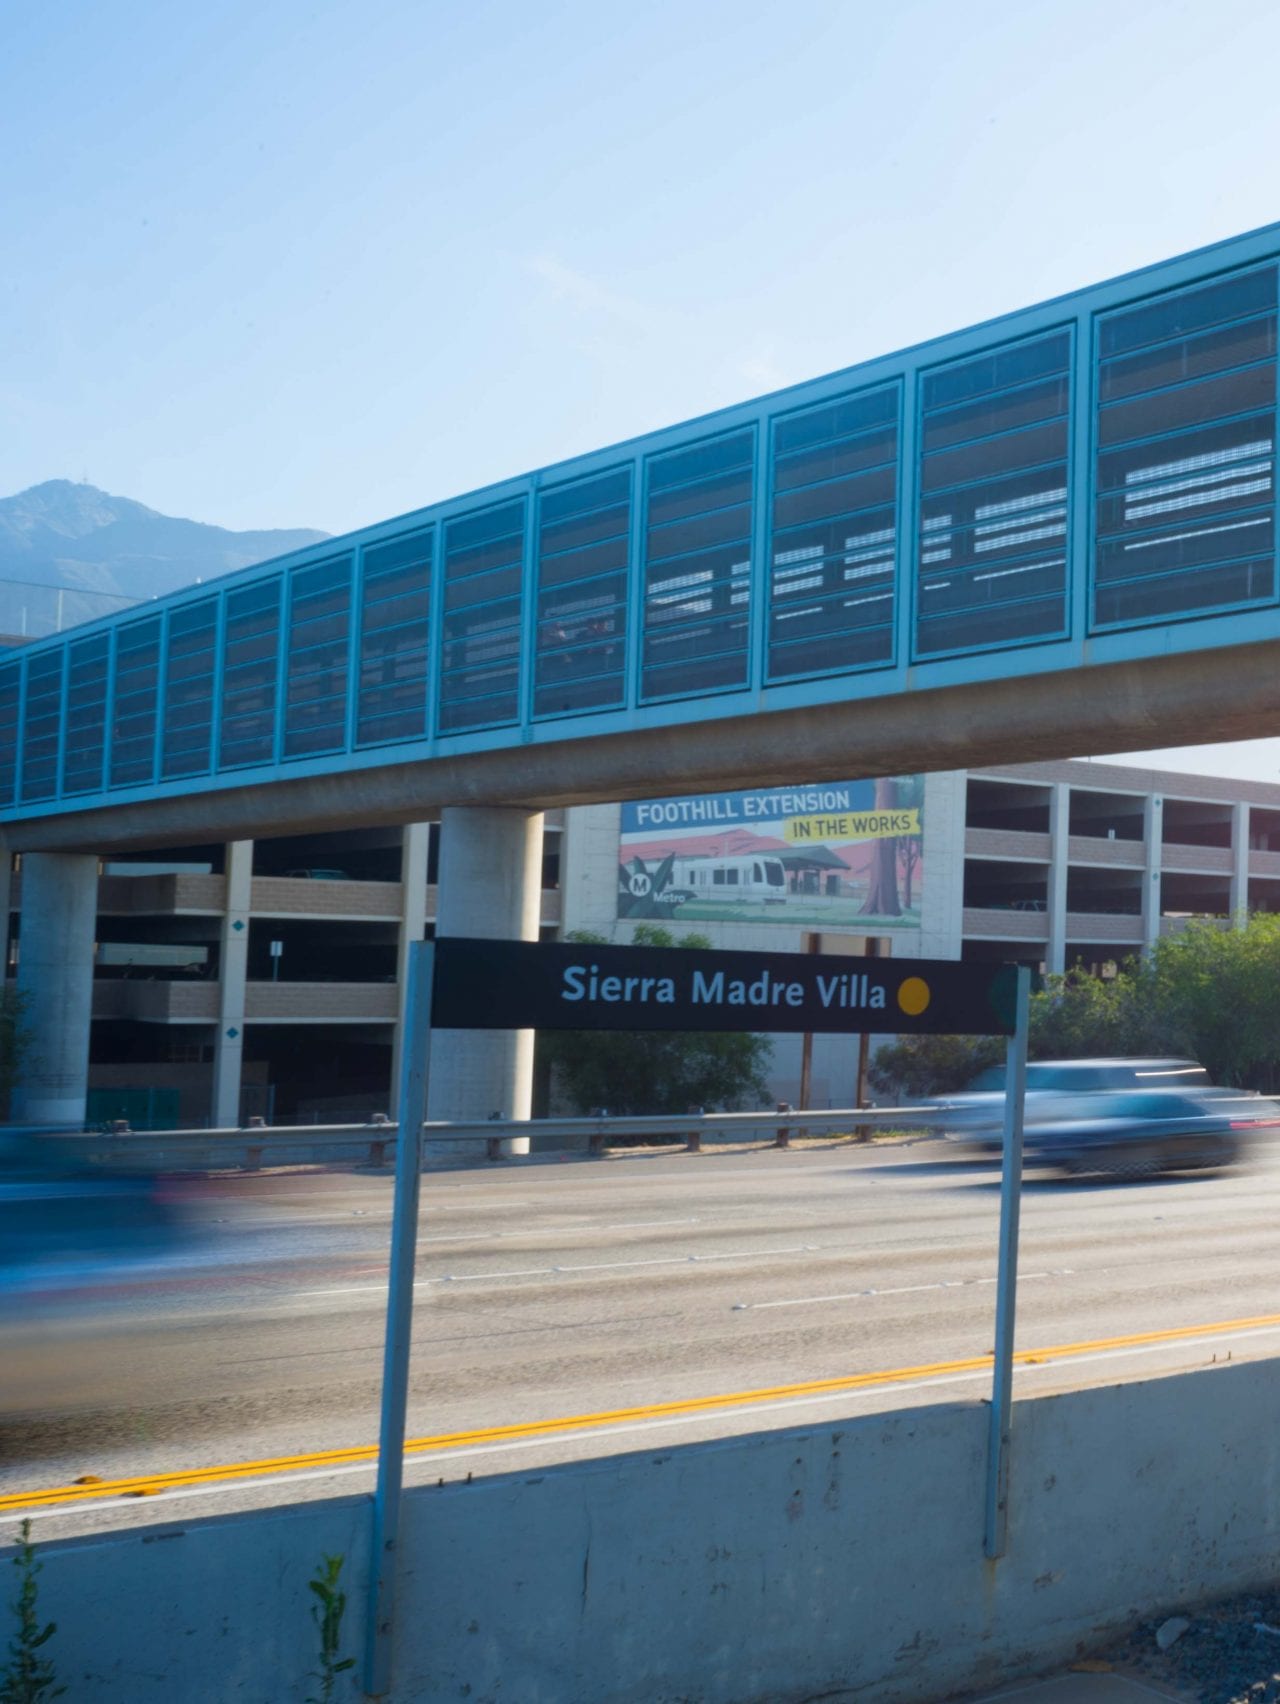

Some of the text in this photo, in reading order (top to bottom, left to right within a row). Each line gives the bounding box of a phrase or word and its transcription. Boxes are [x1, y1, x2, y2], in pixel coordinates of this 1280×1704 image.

[636, 790, 850, 826] FOOTHILL EXTENSION
[793, 814, 911, 838] IN THE WORKS
[653, 891, 686, 904] Metro
[561, 964, 886, 1009] Sierra Madre Villa
